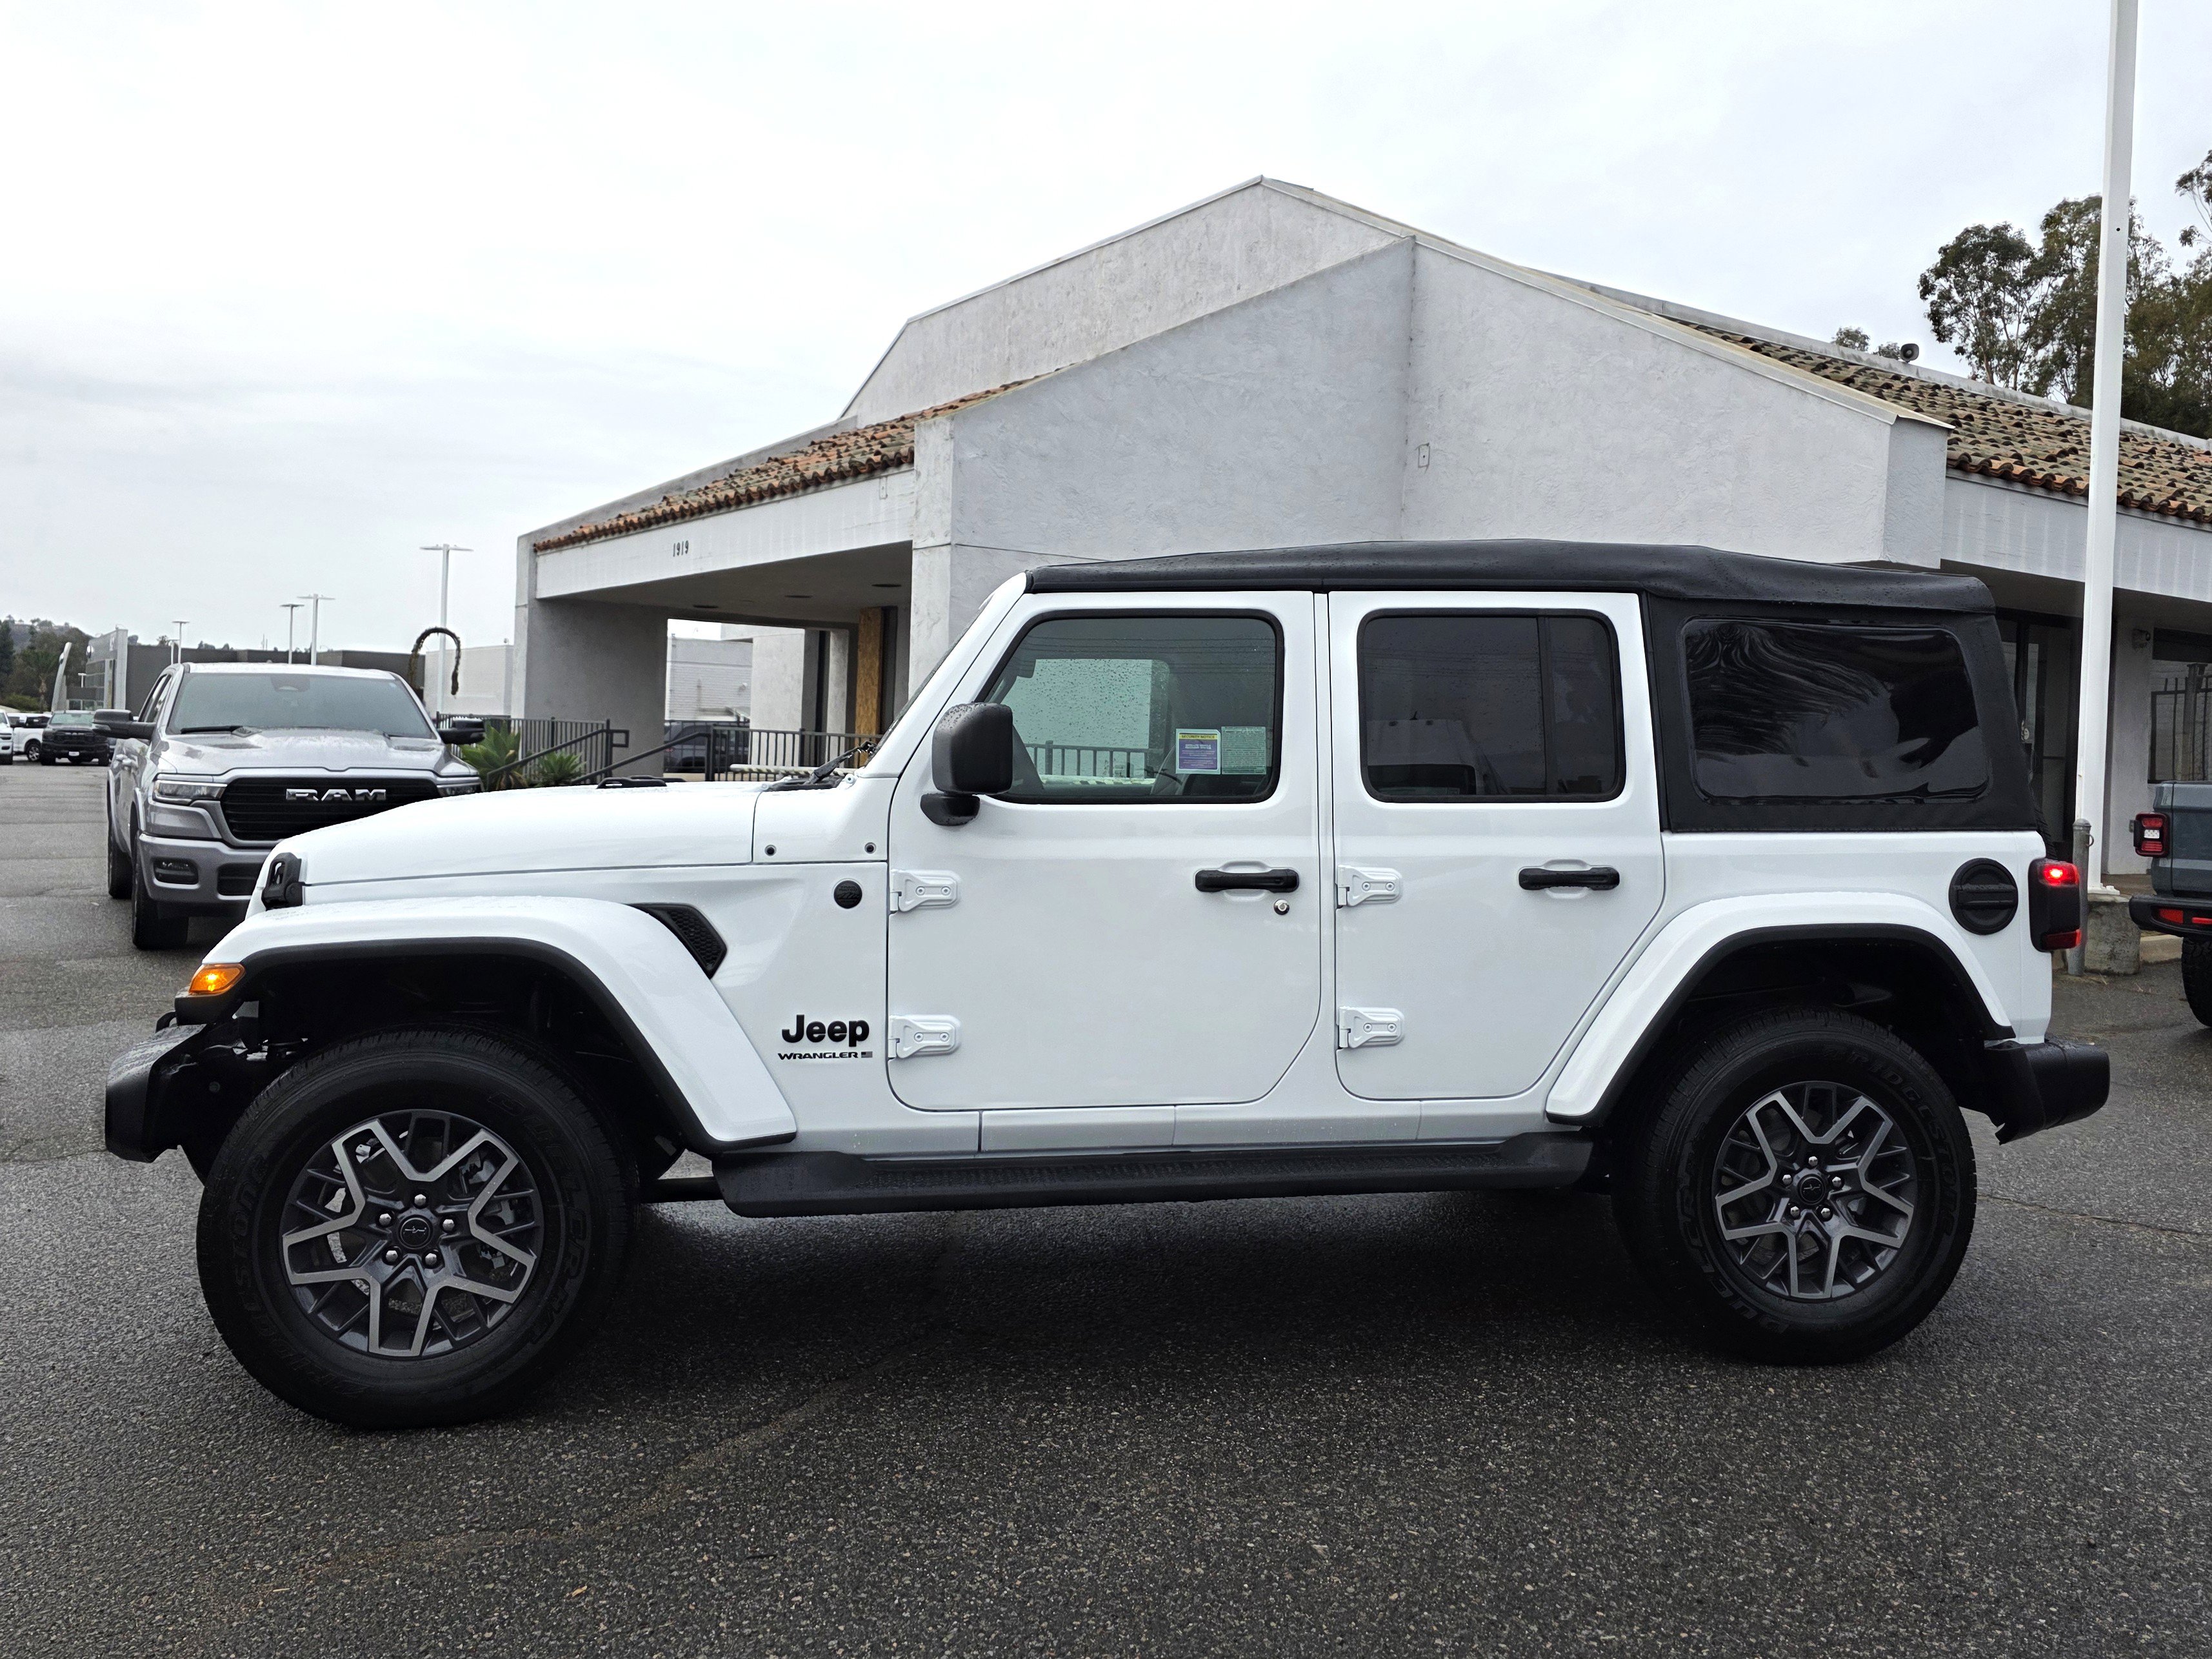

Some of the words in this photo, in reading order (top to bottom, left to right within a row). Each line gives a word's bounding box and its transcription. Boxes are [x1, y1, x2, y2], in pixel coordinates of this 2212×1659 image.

[673, 540, 689, 557] 1919
[286, 789, 386, 801] RAM
[781, 1014, 870, 1047] Jeep
[777, 1051, 859, 1060] WRANGLER
